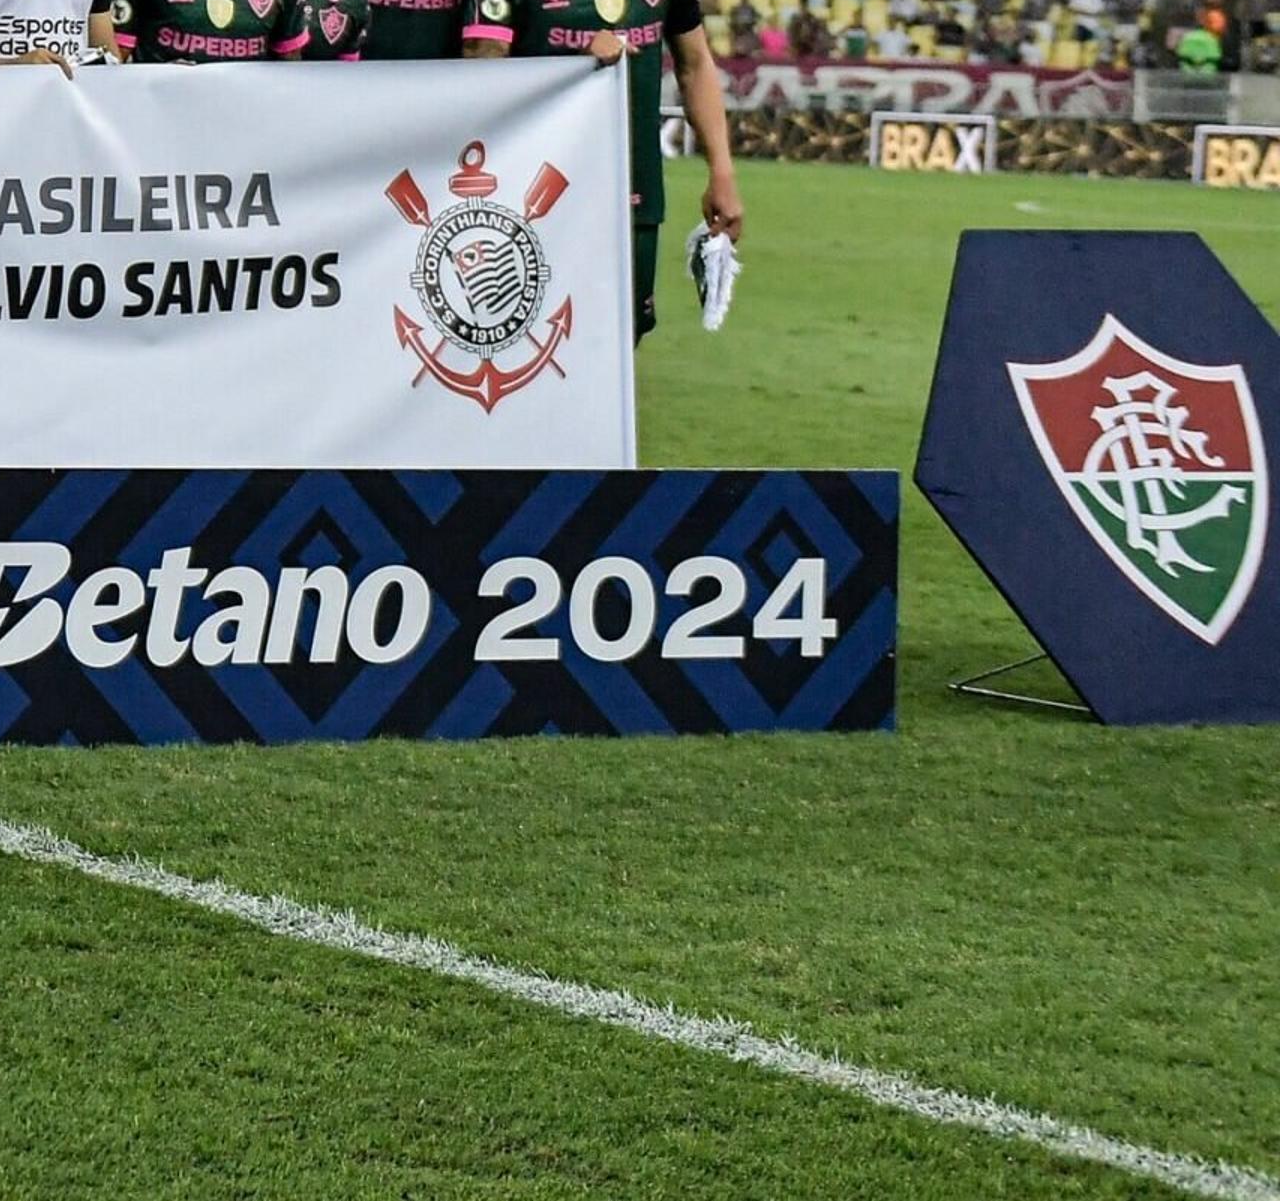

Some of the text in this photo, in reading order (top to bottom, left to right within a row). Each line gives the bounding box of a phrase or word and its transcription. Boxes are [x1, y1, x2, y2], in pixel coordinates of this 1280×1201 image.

[880, 122, 986, 173] BRAX
[1205, 137, 1280, 190] BRA
[122, 252, 342, 319] SANTOS
[424, 212, 514, 286] CORINTHIANS
[516, 229, 539, 322] PAULISTA
[470, 326, 507, 343] 1910
[473, 555, 838, 662] 2024
